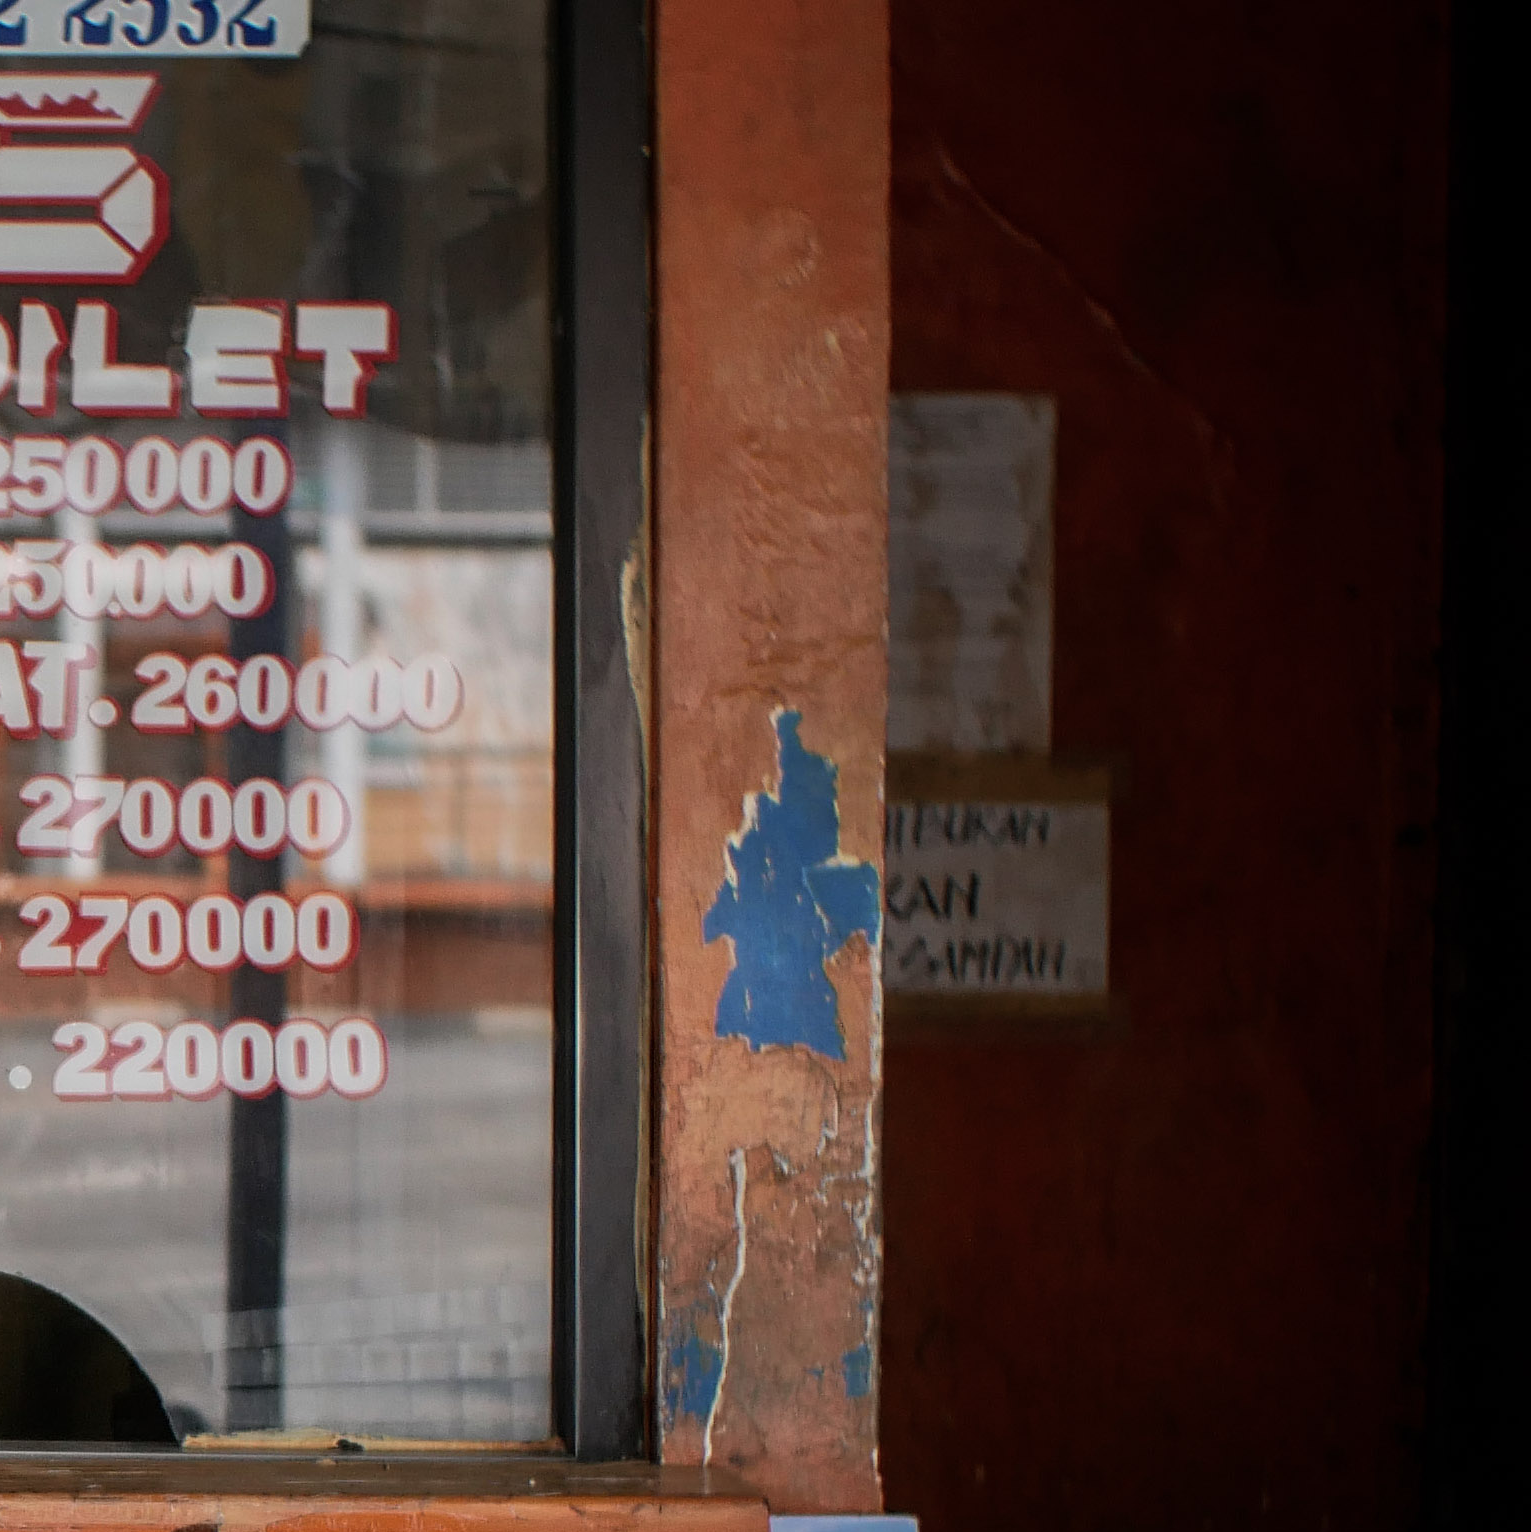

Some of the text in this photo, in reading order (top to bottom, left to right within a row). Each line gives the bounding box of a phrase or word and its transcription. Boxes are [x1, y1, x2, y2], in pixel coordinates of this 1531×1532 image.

[132, 652, 465, 734] 260000
[17, 774, 351, 859] 270000
[18, 892, 359, 975] 270000
[52, 1017, 390, 1102] 220000
